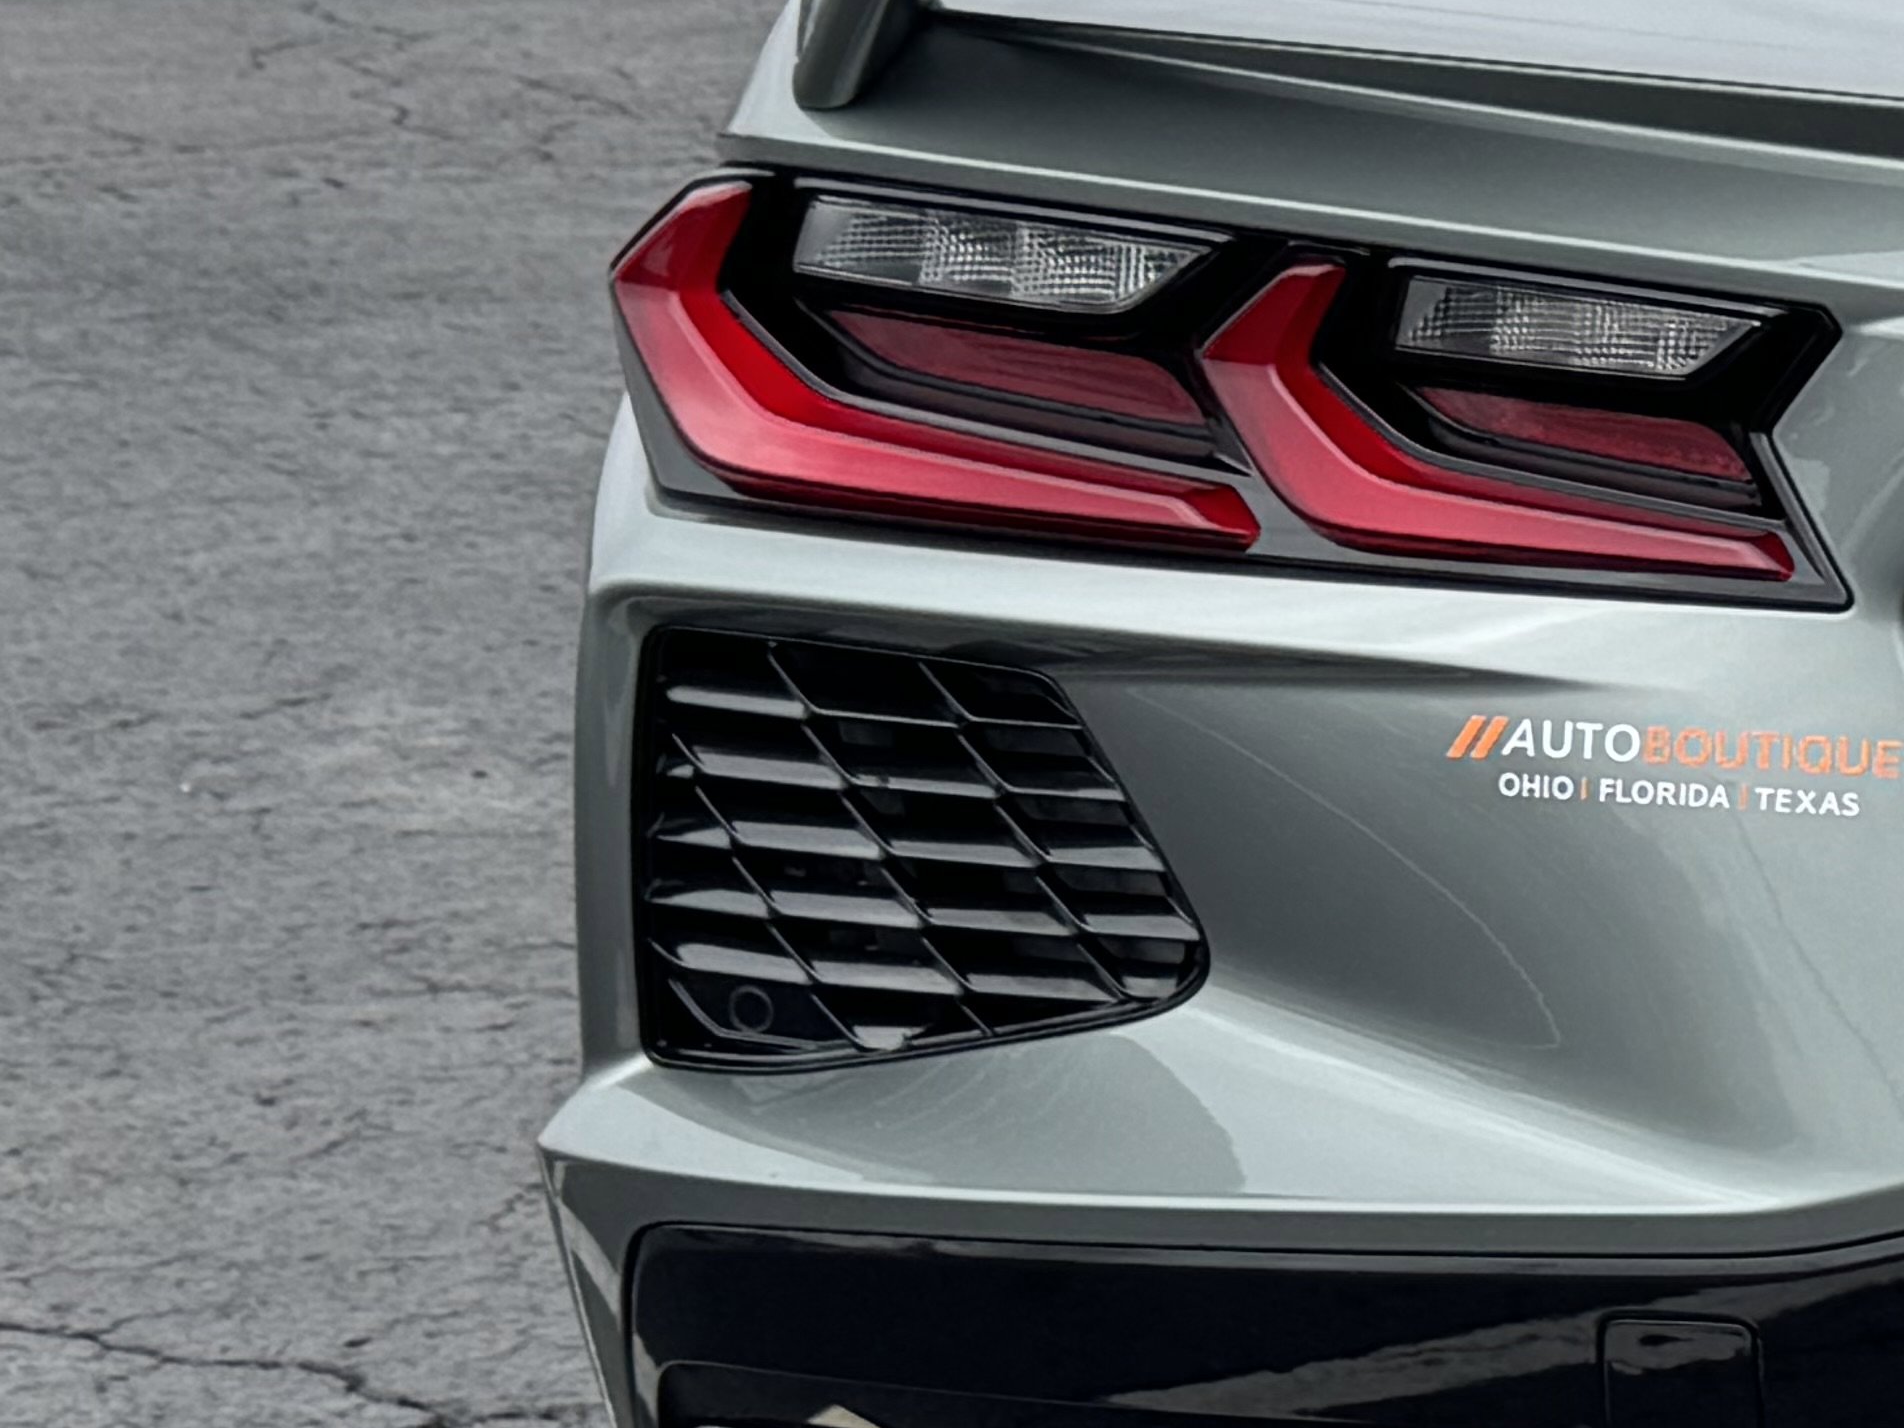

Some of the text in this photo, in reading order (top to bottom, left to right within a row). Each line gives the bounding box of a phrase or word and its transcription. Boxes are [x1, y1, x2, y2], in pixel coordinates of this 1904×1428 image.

[1502, 717, 1904, 779] AUTOBOUTIQUE
[1499, 773, 1861, 818] OHIO FLORIDA TEXAS
